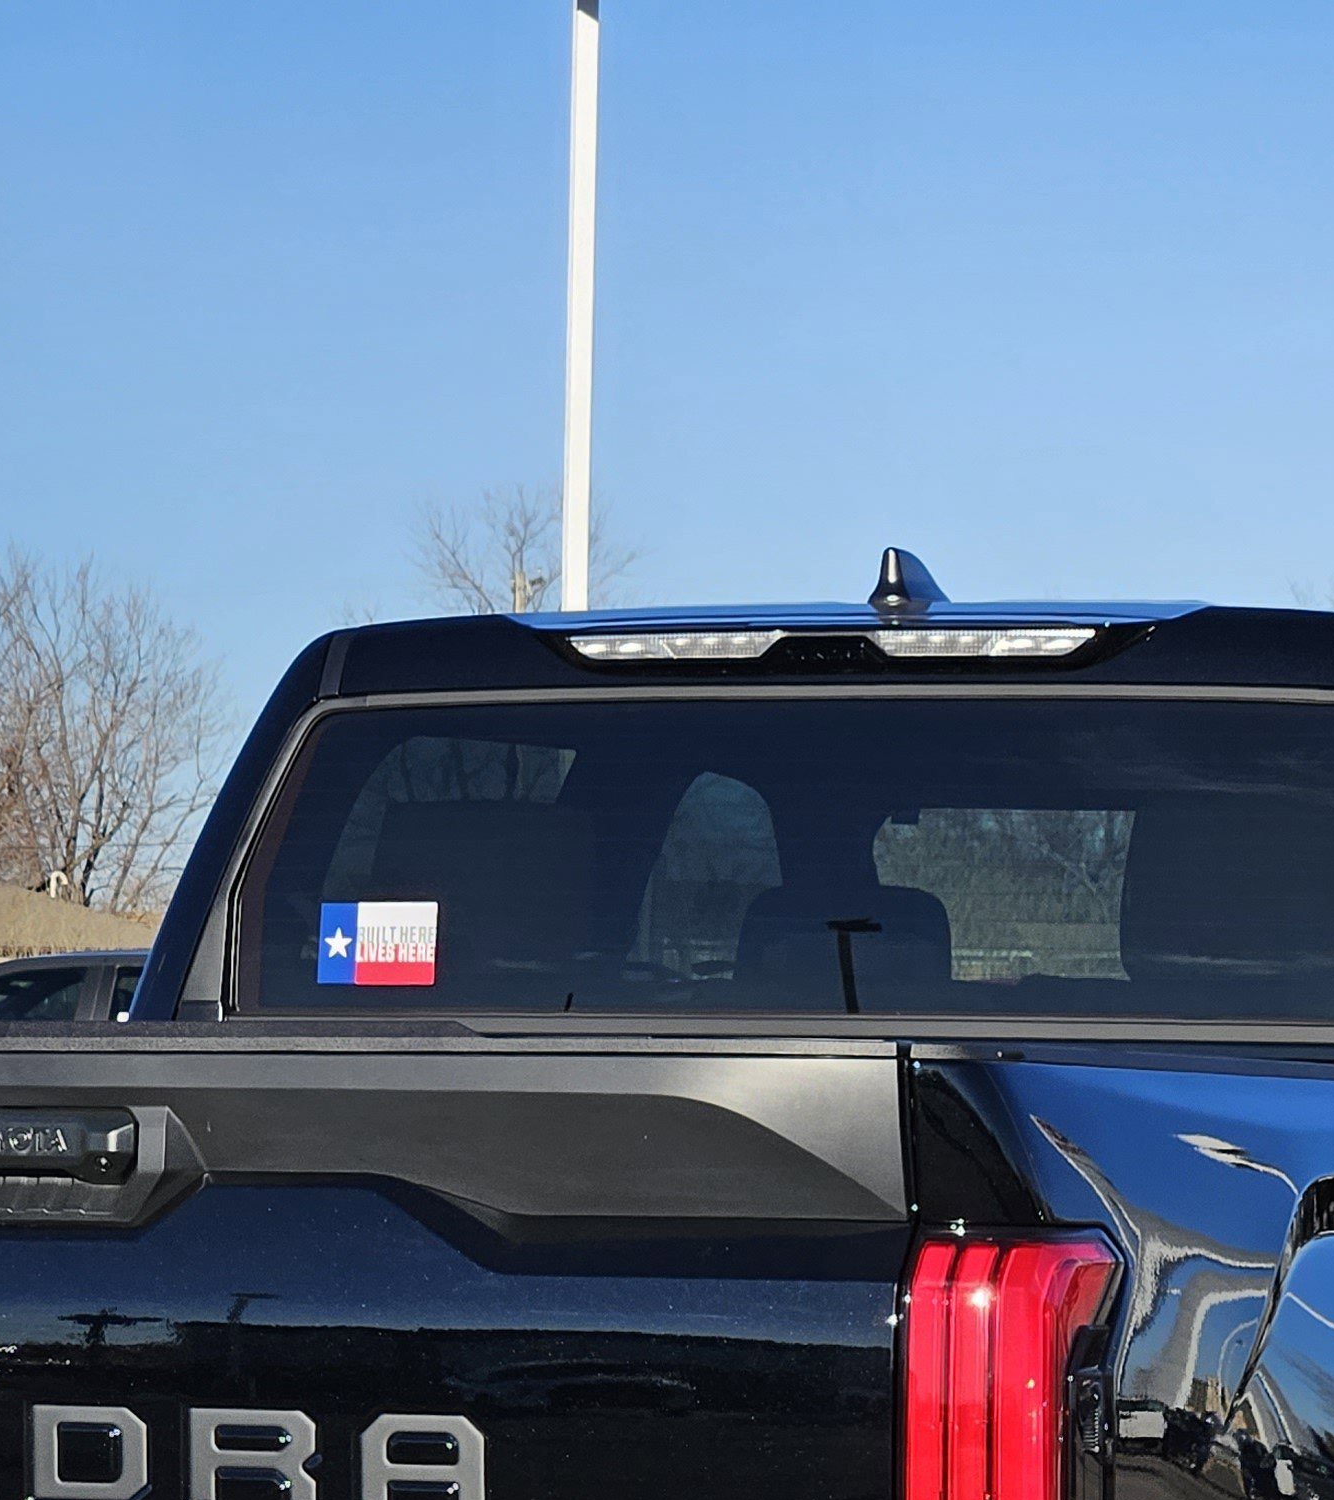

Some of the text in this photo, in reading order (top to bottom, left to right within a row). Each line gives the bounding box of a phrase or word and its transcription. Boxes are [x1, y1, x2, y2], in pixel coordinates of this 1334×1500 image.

[359, 926, 435, 944] BUILT HERE
[356, 943, 434, 963] LIVES HERE
